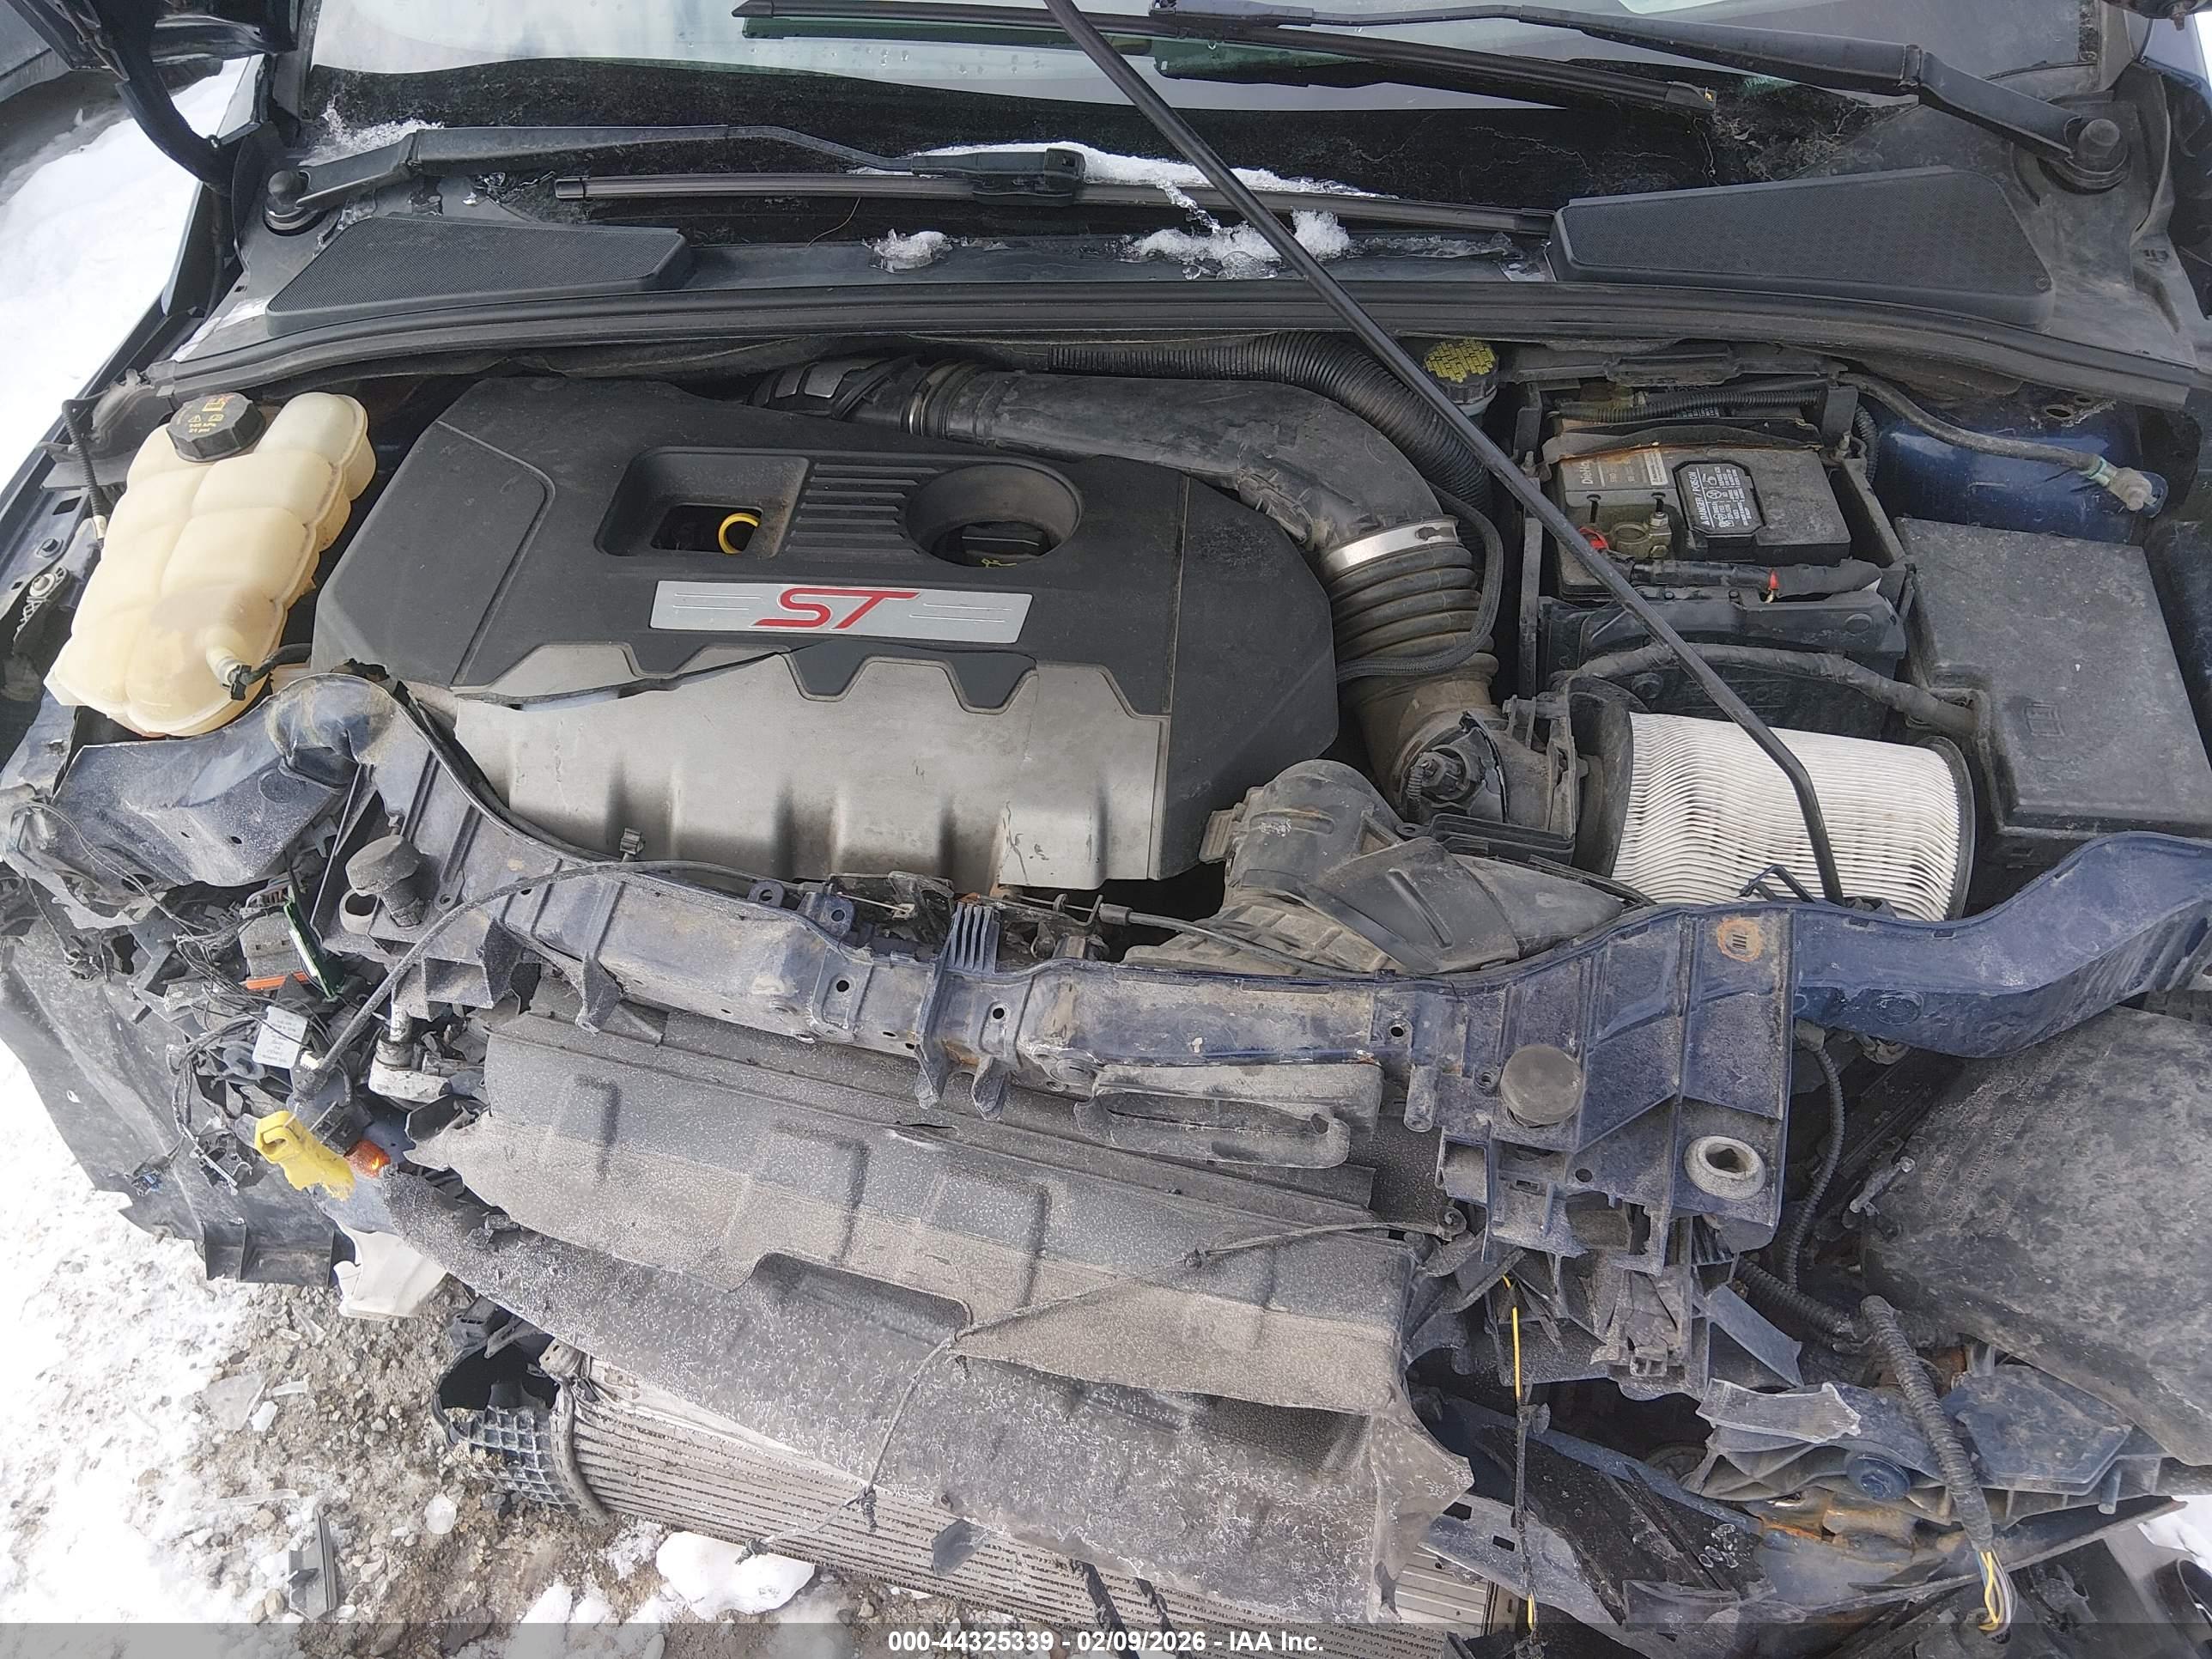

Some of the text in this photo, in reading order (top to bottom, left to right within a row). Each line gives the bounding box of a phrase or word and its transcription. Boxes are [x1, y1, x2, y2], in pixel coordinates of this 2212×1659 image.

[1687, 471, 1701, 492] POISON
[1695, 497, 1710, 520] DANGER
[749, 586, 921, 630] ST
